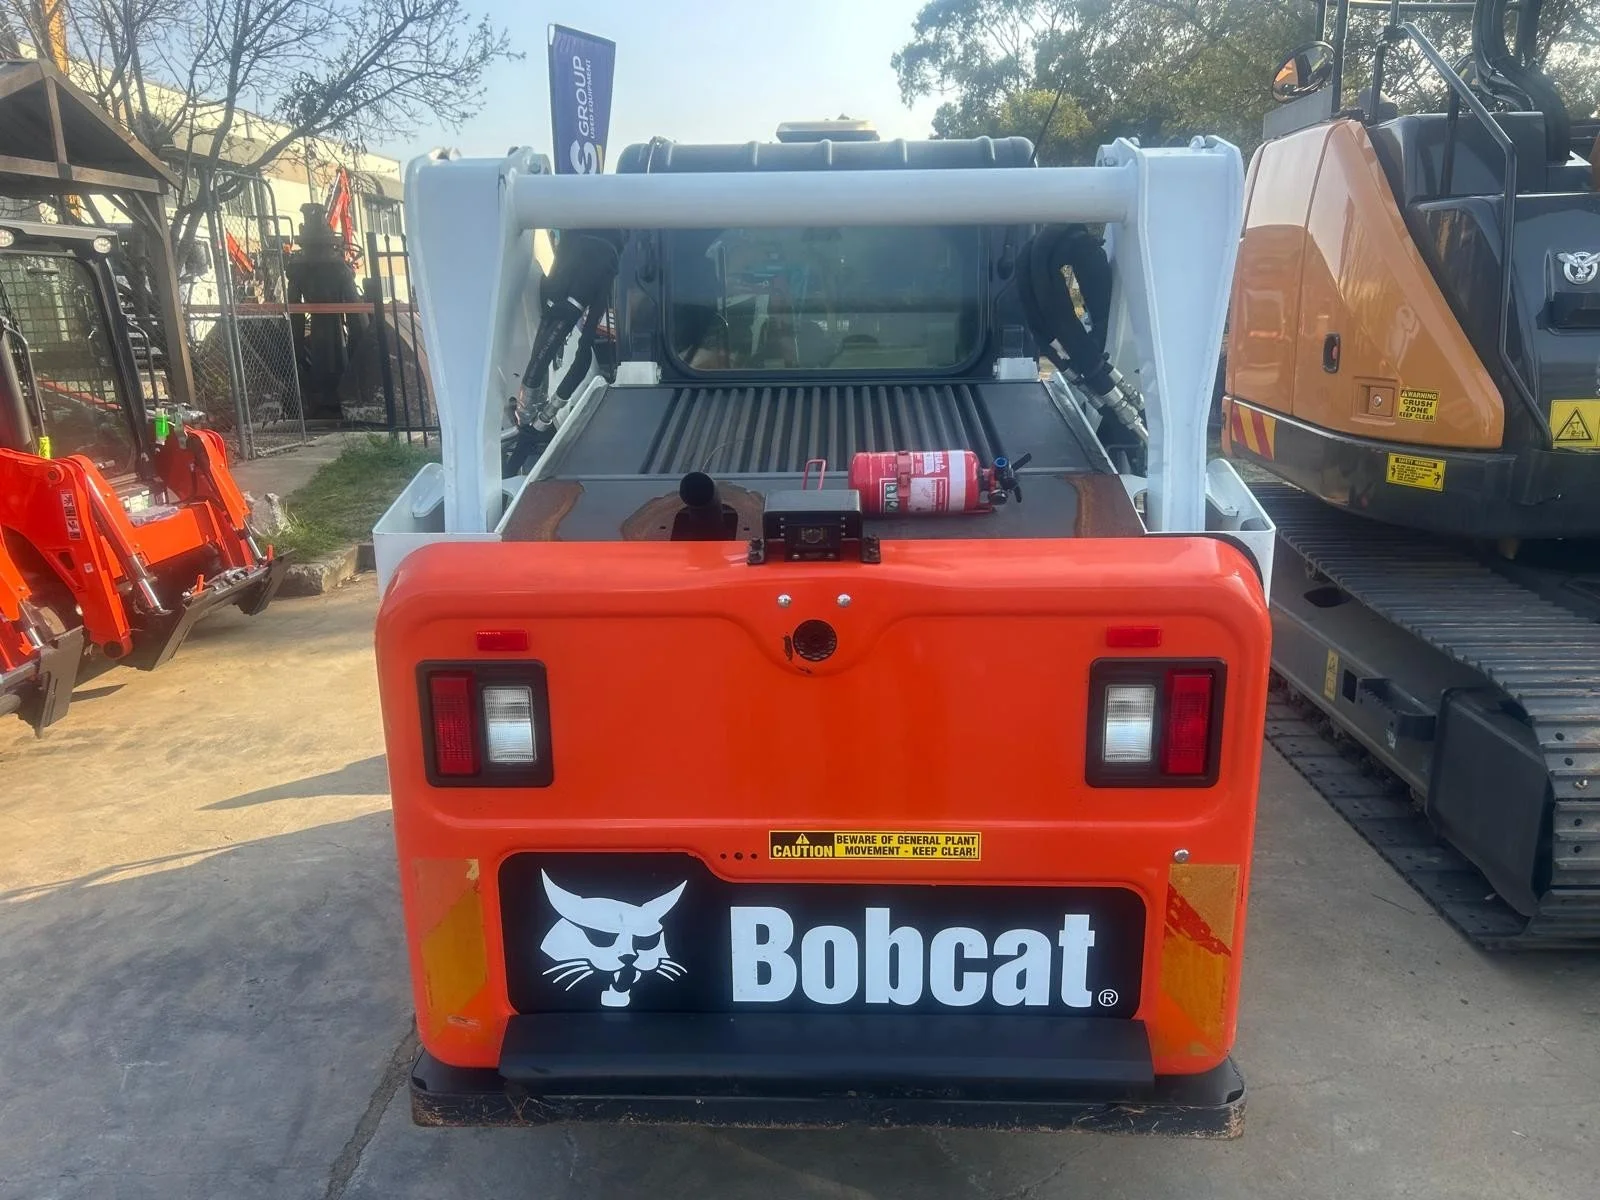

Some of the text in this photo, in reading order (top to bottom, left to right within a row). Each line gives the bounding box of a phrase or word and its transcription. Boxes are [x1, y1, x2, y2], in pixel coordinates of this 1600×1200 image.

[586, 59, 594, 113] EQUIPMENT
[573, 56, 589, 136] GROUP
[1407, 391, 1437, 400] WARNING
[1402, 398, 1433, 408] CRUSH
[1404, 405, 1429, 414] ZONE
[836, 835, 977, 846] BEWARE OF GENERAL PLANT
[772, 844, 833, 858] CAUTION
[844, 845, 900, 856] MOVEMENT
[912, 846, 938, 856] KEEP
[941, 846, 976, 857] CLEAR!
[730, 906, 1096, 1008] Bobcat
